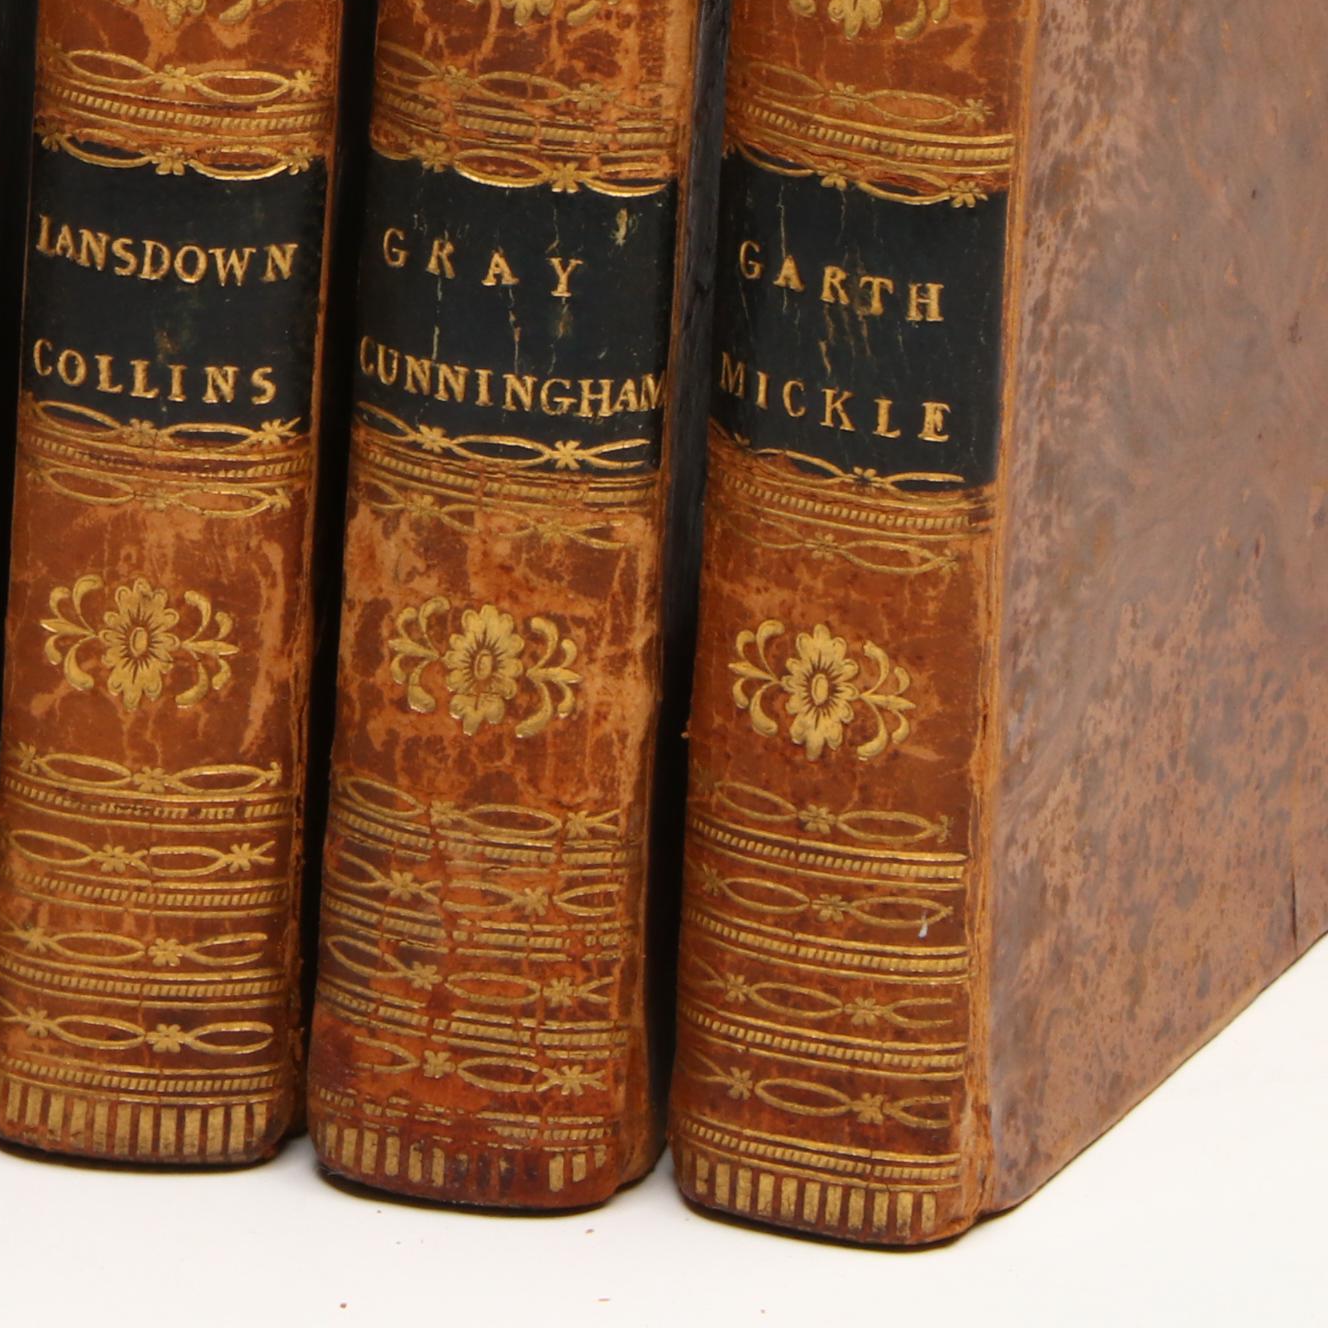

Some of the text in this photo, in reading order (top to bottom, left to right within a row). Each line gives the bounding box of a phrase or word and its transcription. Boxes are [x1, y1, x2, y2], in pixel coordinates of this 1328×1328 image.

[382, 227, 584, 298] GRAY
[738, 239, 945, 322] GARTH
[33, 337, 277, 404] COLLINS
[720, 352, 950, 443] MICKLE
